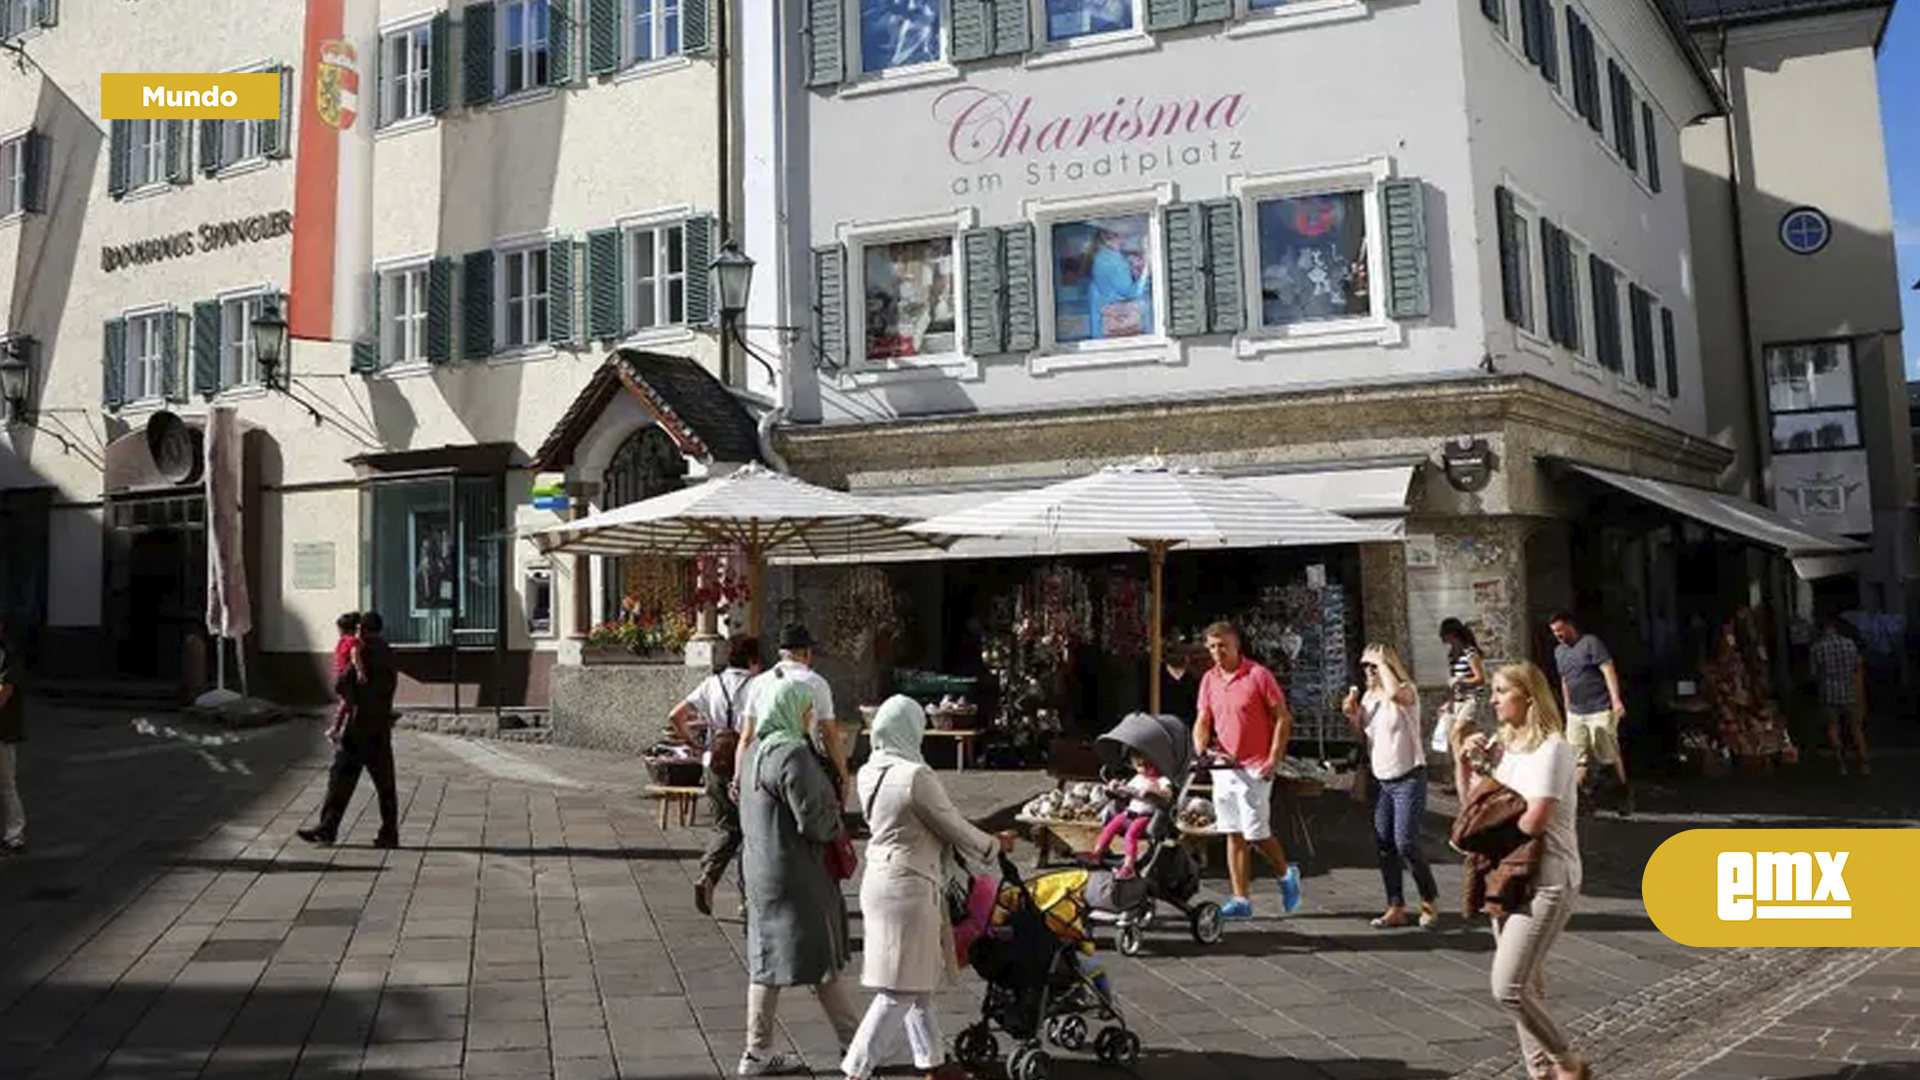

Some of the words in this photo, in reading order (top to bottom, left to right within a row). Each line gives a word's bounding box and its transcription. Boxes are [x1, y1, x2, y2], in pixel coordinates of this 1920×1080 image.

[932, 86, 1247, 165] Charisma
[951, 171, 1002, 195] am
[1026, 138, 1242, 185] Stadtplatz
